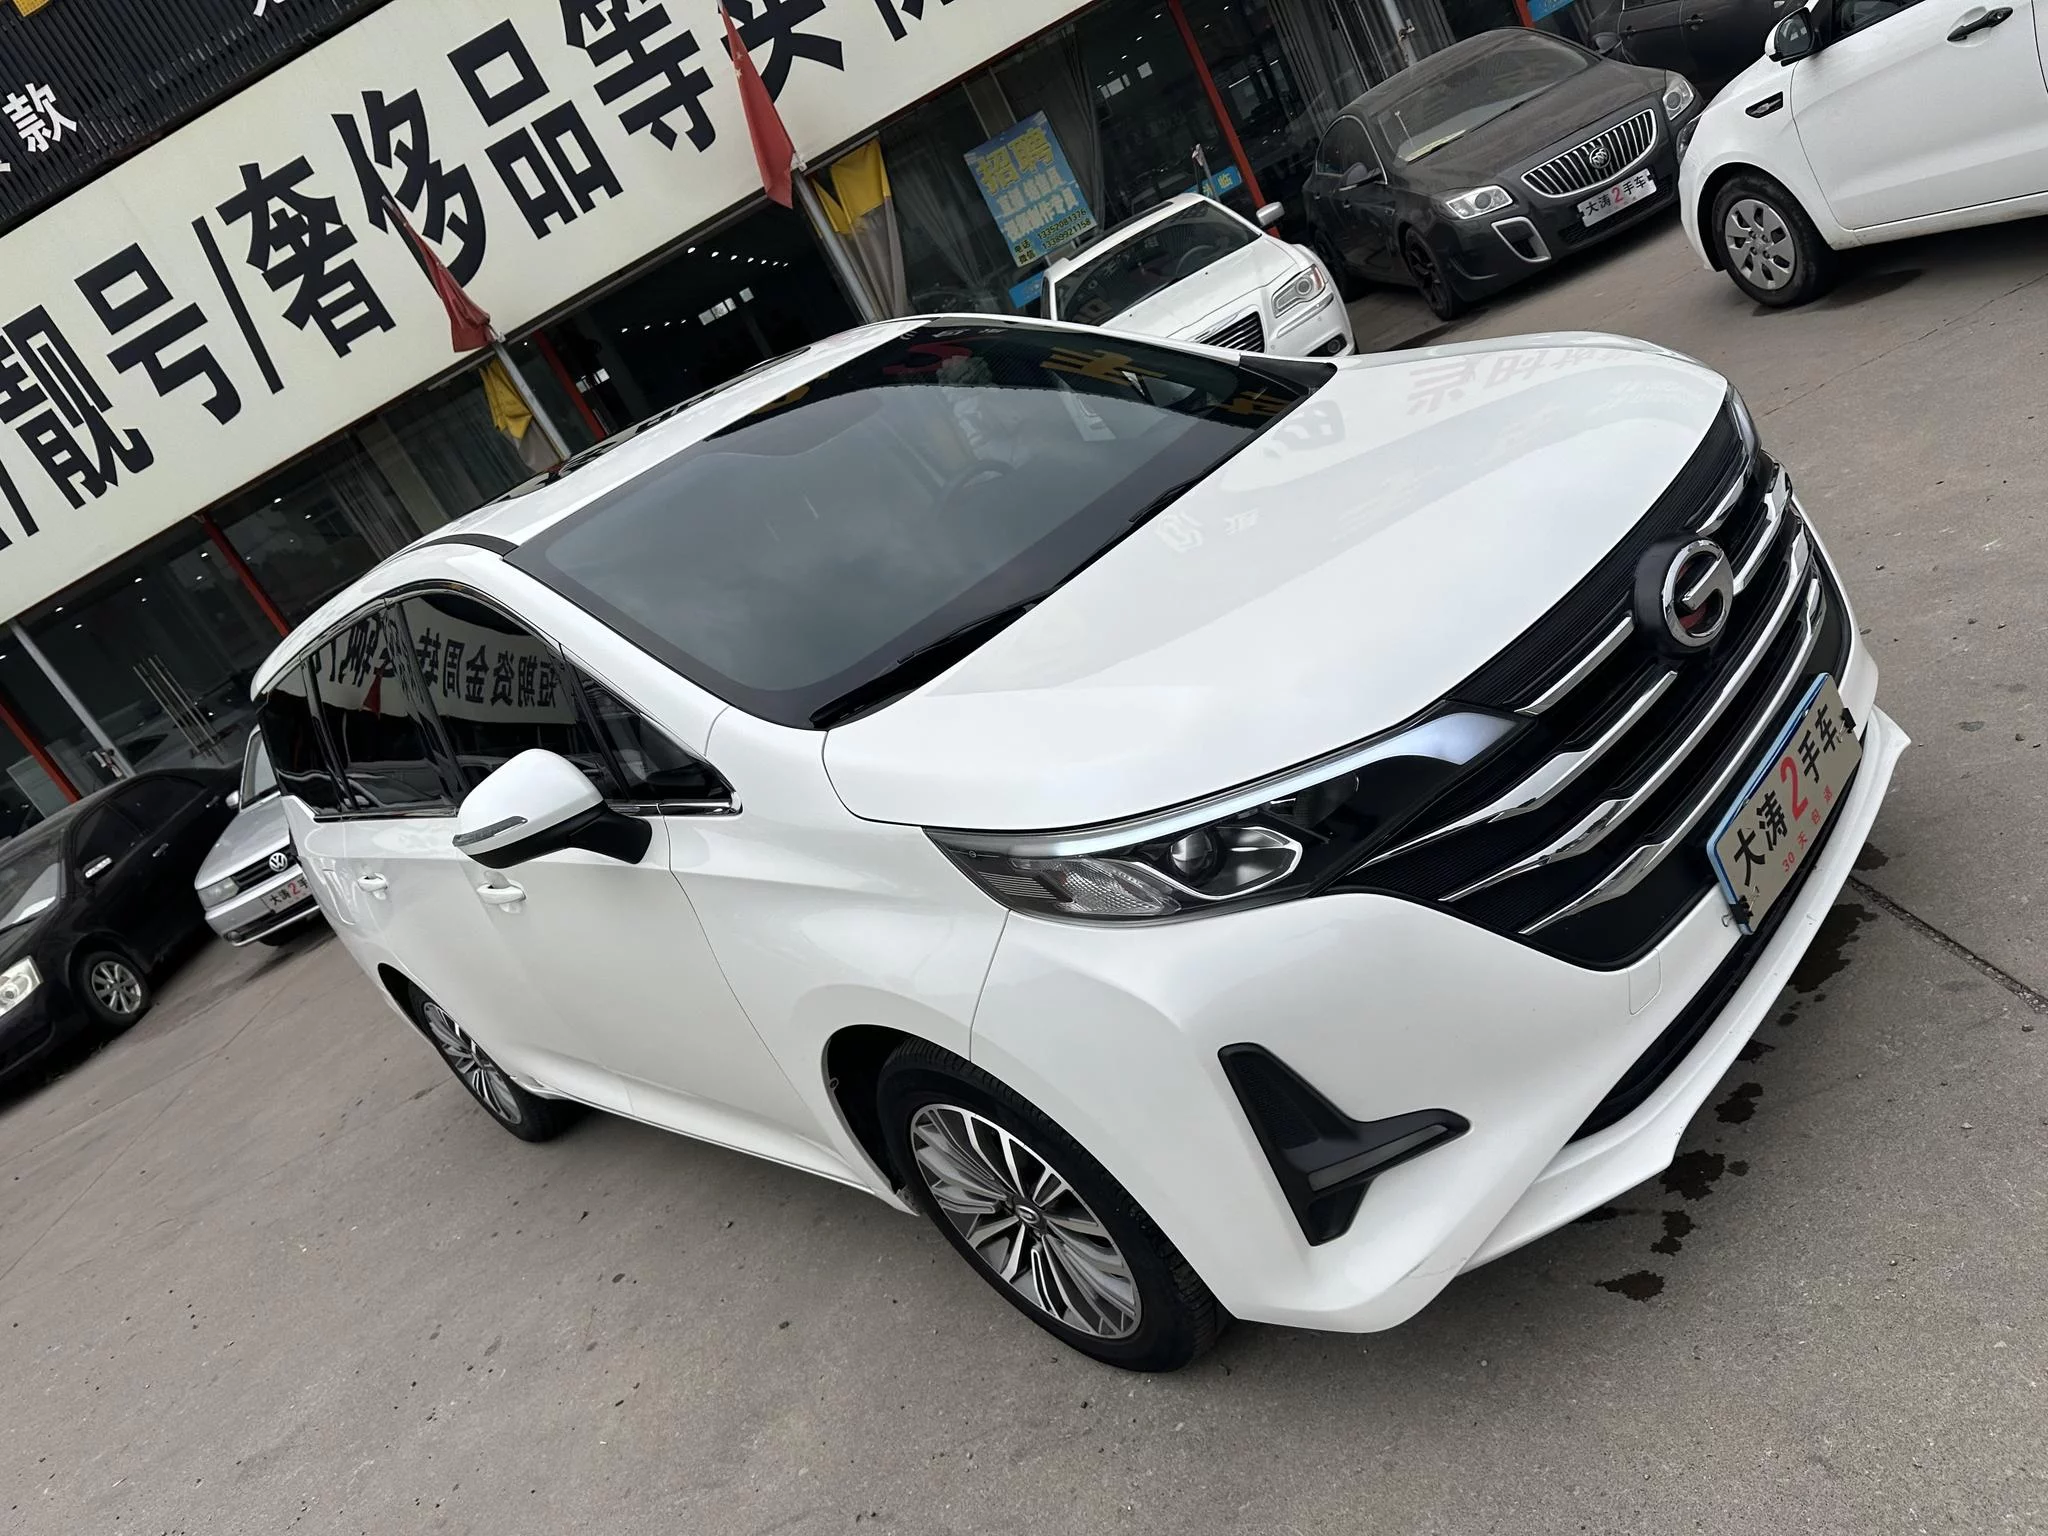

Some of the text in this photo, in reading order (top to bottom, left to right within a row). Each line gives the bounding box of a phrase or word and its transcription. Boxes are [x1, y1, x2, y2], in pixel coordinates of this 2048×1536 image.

[976, 127, 1054, 195] 招聘
[1586, 175, 1647, 216] 大涛2手车
[1733, 703, 1838, 886] 大涛2手车
